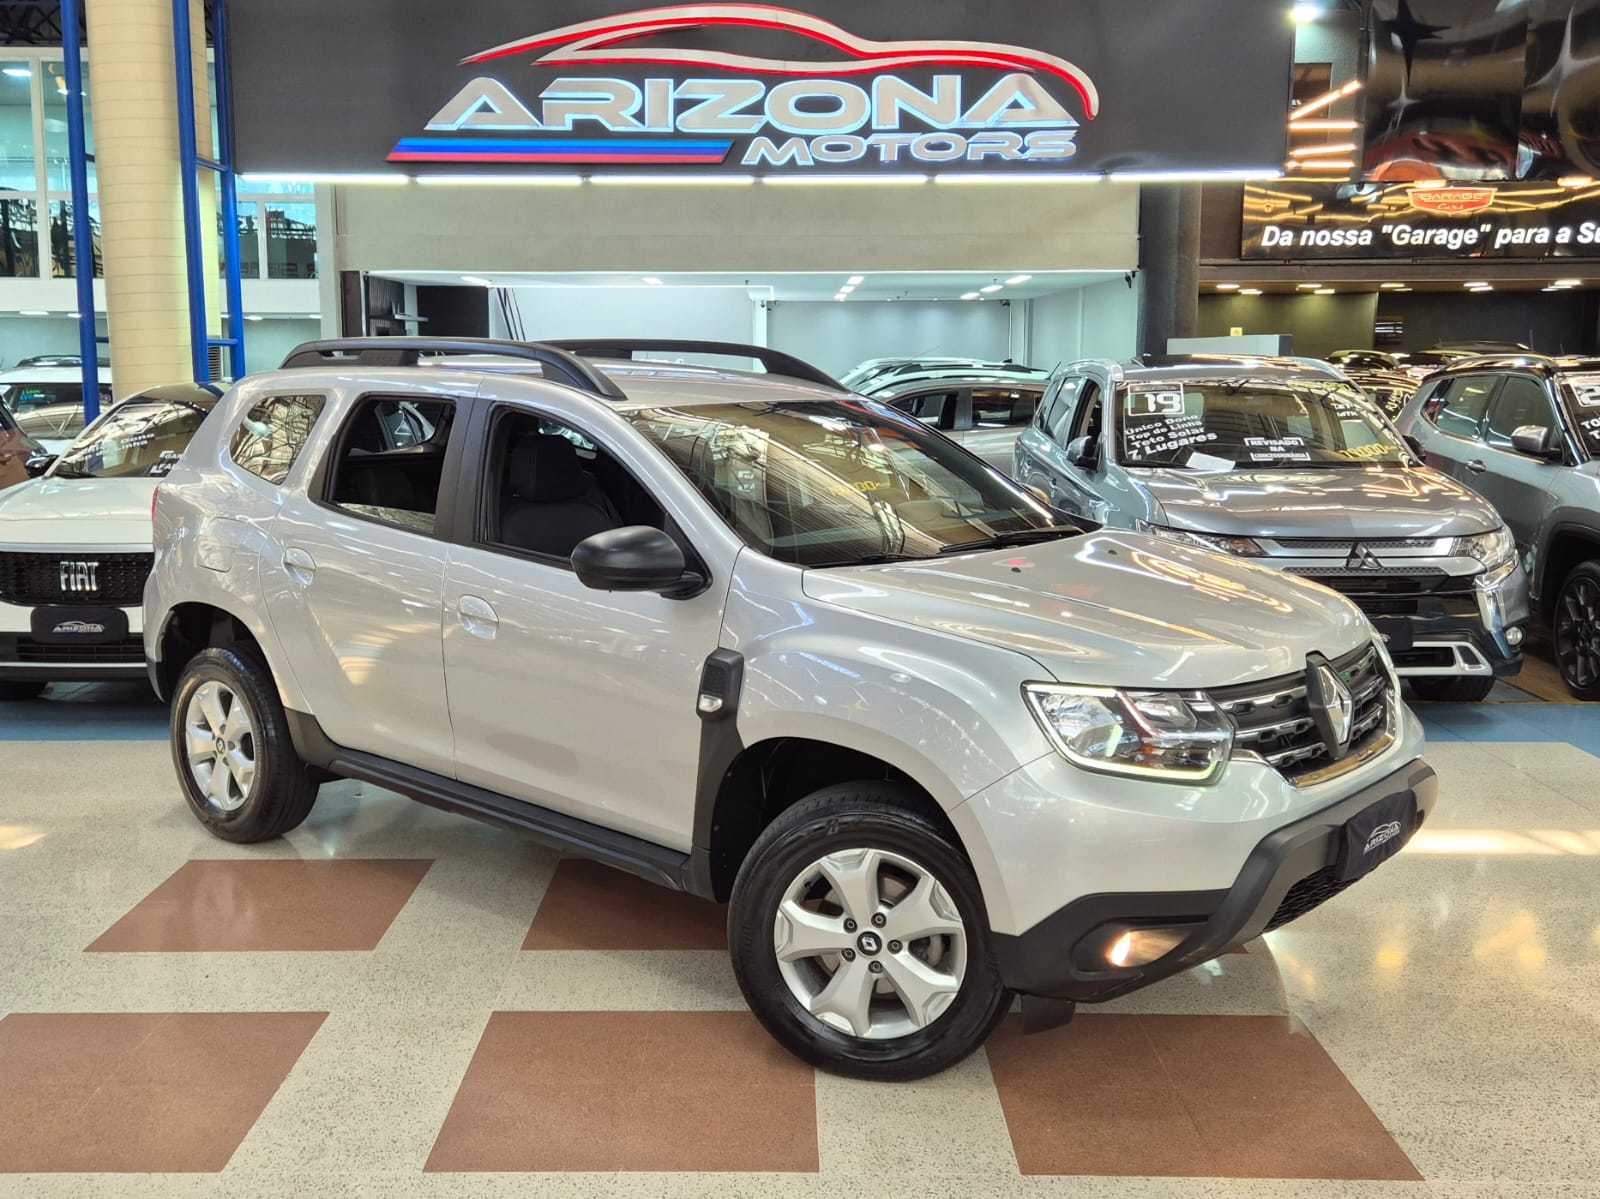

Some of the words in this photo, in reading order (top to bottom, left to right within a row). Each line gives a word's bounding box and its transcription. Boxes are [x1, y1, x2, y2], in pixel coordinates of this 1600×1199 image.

[424, 74, 1080, 131] ARIZONA
[741, 129, 1078, 166] MOTORS
[1417, 192, 1487, 201] GARAGE
[1261, 225, 1294, 247] Da
[1300, 228, 1373, 247] nossa
[1382, 223, 1491, 251] "Garage"
[1494, 227, 1551, 249] para
[1555, 226, 1572, 244] a
[1144, 393, 1182, 413] 19
[1128, 432, 1151, 441] Top
[1153, 427, 1168, 435] de
[1169, 420, 1203, 431] Linha
[1165, 414, 1198, 425] Dono
[1131, 436, 1165, 449] Teto
[1167, 426, 1205, 439] Solar
[1144, 432, 1218, 455] Lugares
[60, 561, 99, 591] FIAT
